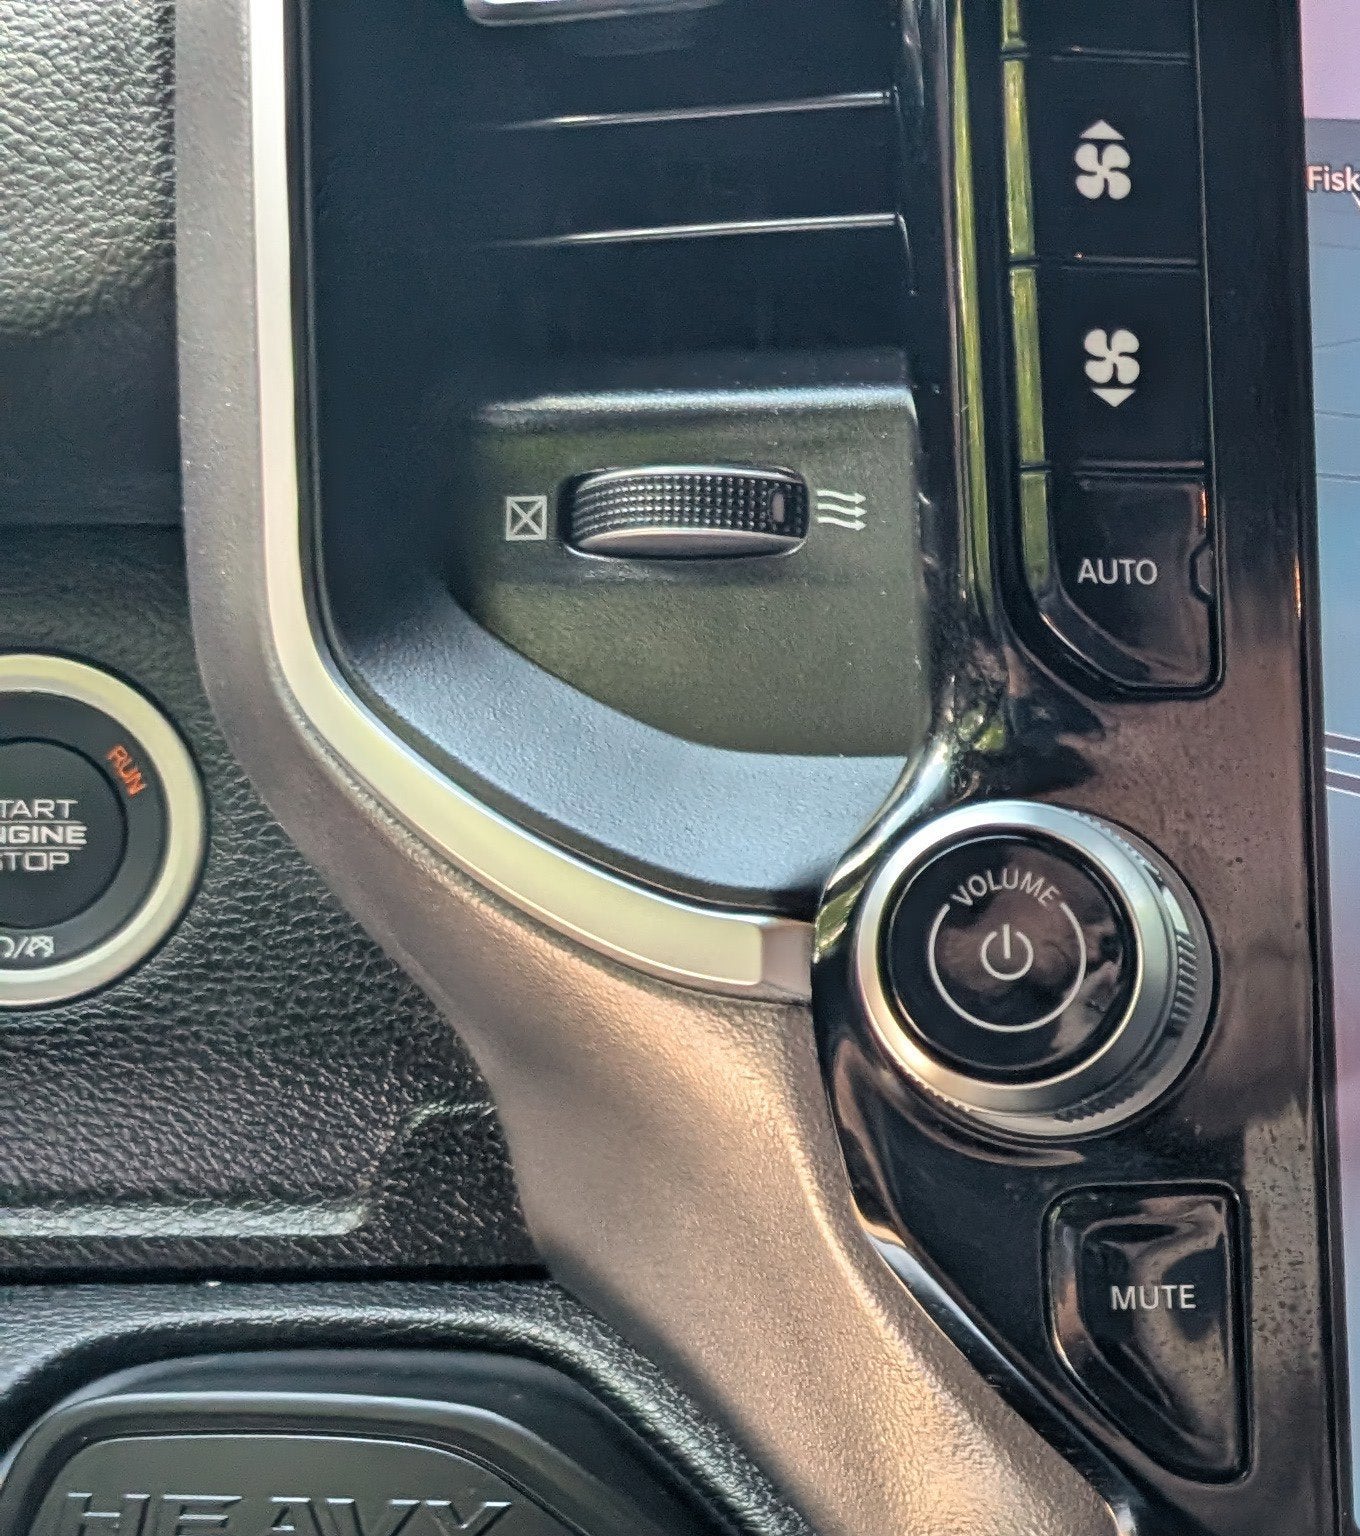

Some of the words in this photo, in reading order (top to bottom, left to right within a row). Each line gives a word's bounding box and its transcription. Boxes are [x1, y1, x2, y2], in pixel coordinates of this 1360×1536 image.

[1077, 558, 1159, 586] AUTO
[106, 744, 148, 798] RUN
[0, 799, 79, 819] TART
[0, 825, 88, 845] GINE
[0, 851, 70, 872] TOP
[952, 868, 1061, 908] VOLUME
[1110, 1284, 1198, 1310] MUTE
